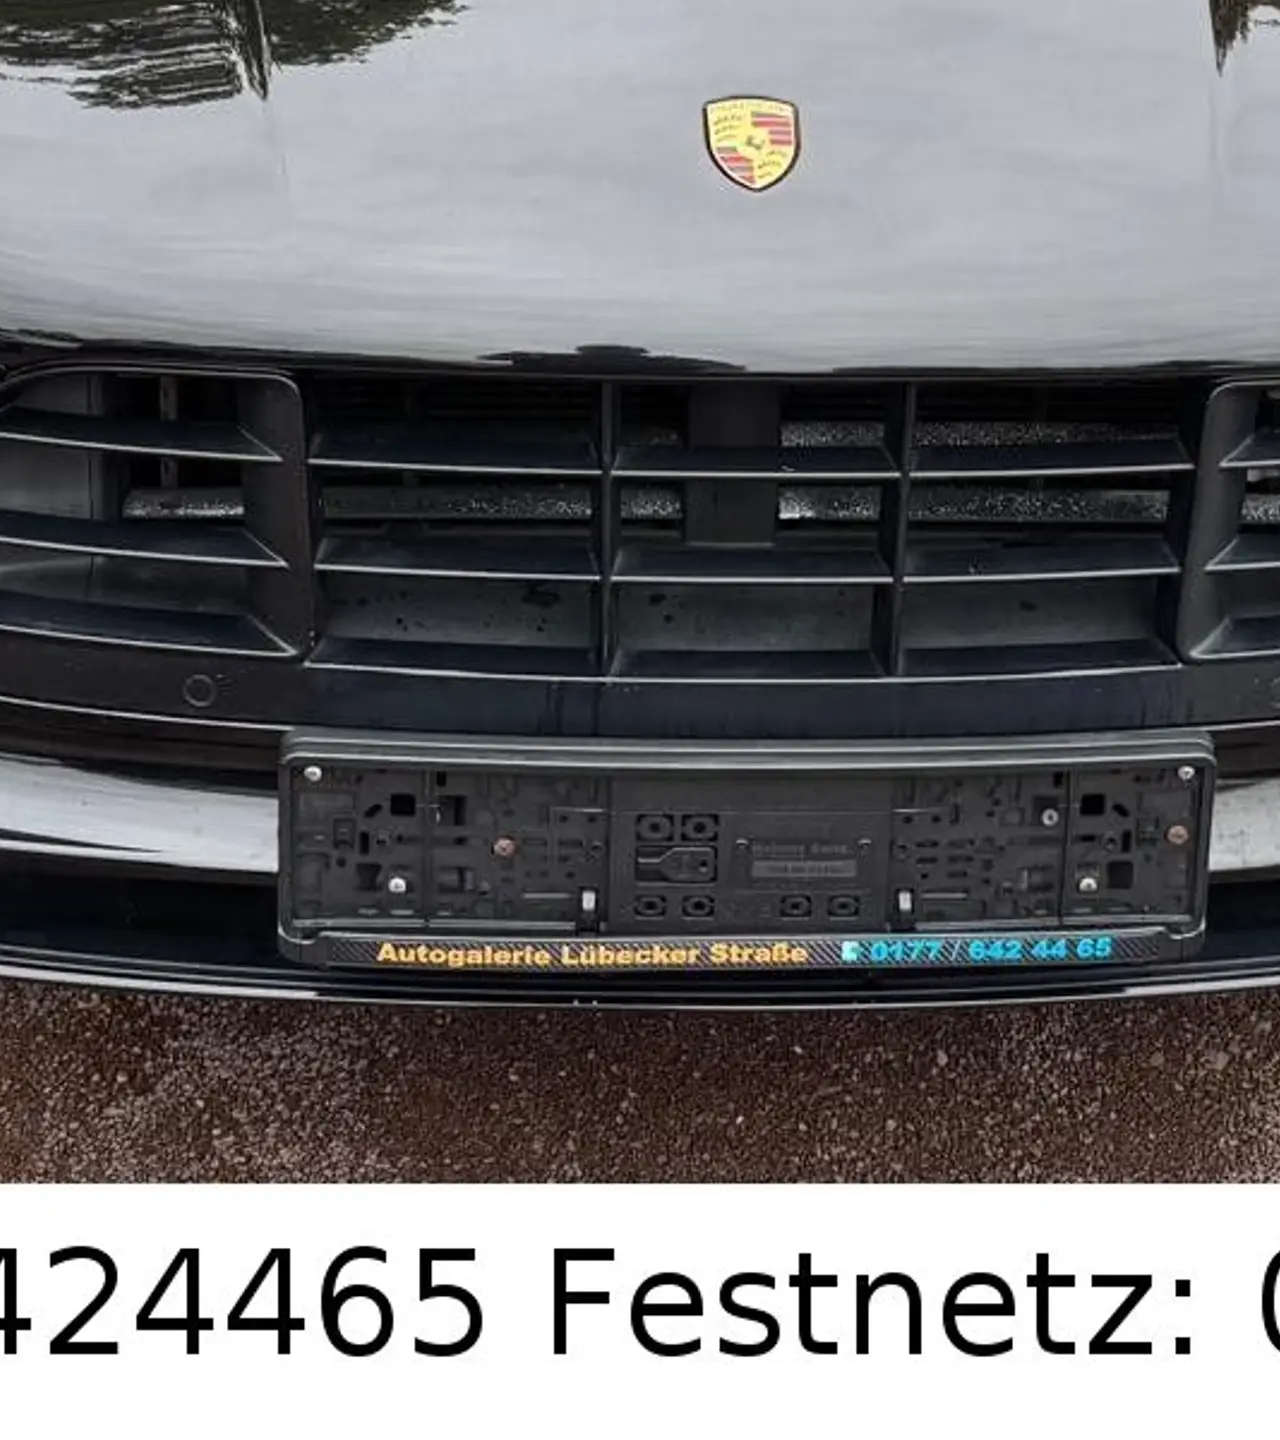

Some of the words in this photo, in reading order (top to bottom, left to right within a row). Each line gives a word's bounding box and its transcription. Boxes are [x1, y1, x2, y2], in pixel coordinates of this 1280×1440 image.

[376, 942, 551, 968] Autogalerie
[562, 944, 702, 966] Lübecker
[708, 941, 810, 965] Straße
[870, 940, 943, 960] 0177
[969, 938, 1022, 960] 642
